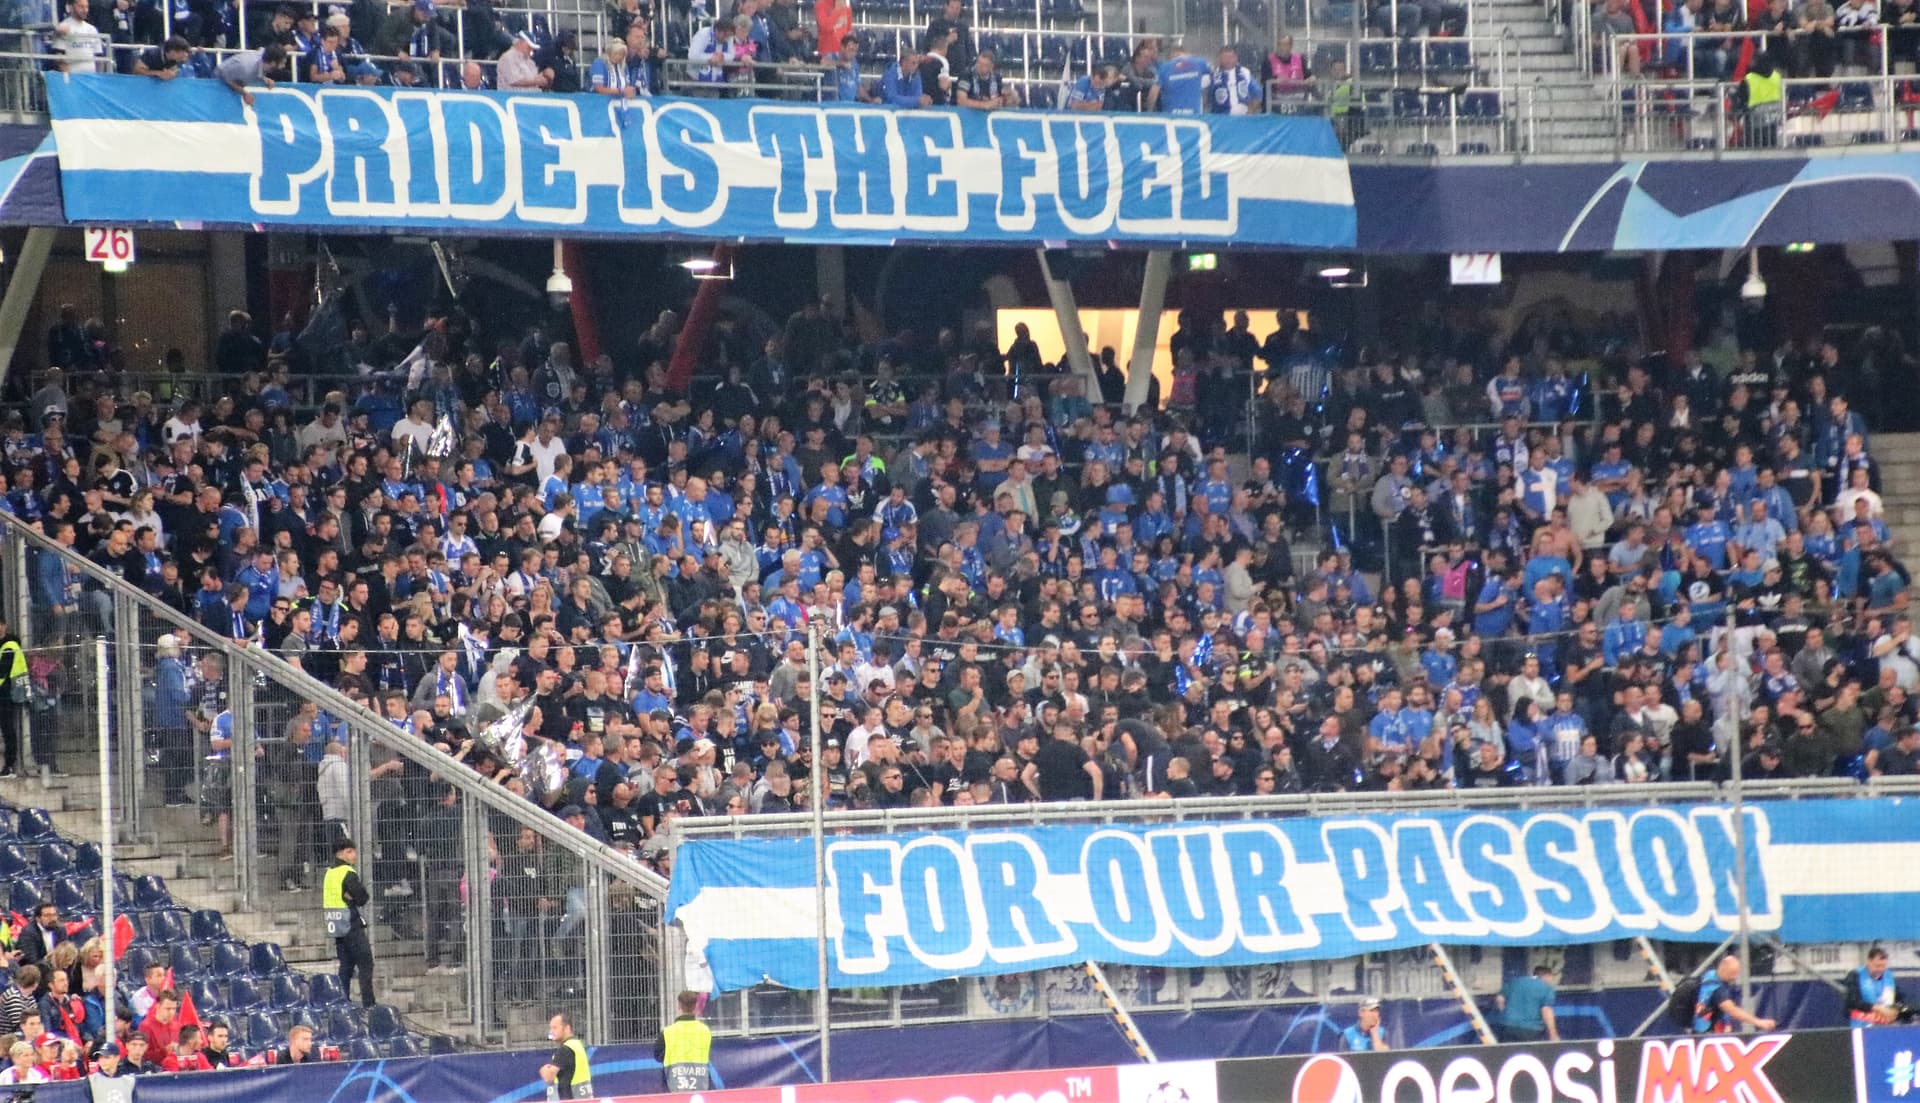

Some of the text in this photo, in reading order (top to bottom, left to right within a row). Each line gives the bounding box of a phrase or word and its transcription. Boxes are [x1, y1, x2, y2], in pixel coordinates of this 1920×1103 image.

[250, 88, 1238, 235] PRIDE IS THE FUEL
[89, 227, 129, 259] 26
[1456, 251, 1496, 280] 27
[827, 807, 1782, 974] FOR OUR PASSION
